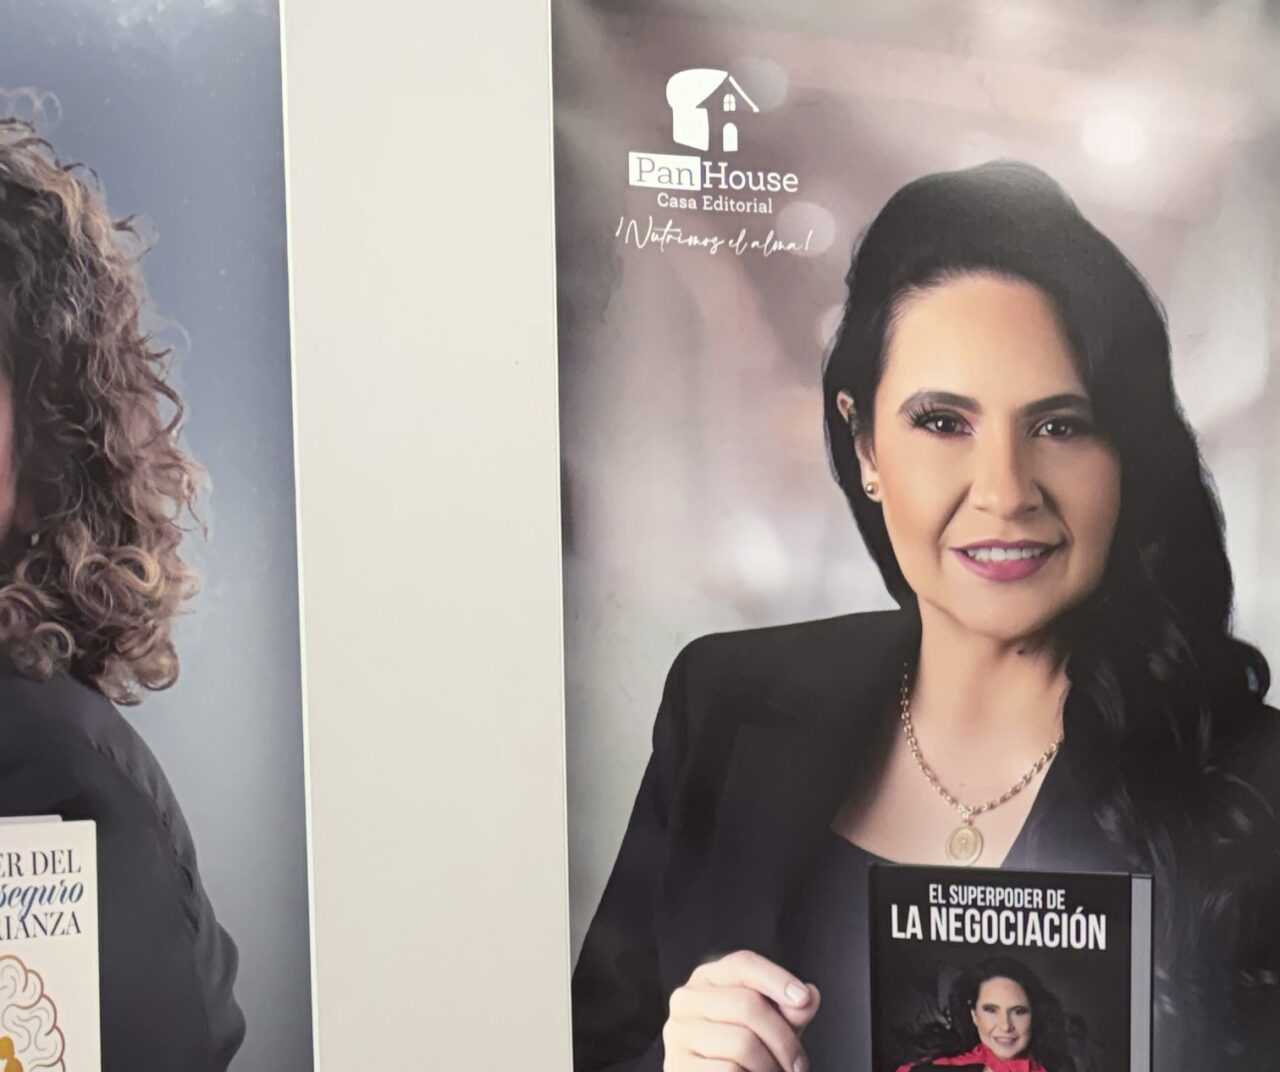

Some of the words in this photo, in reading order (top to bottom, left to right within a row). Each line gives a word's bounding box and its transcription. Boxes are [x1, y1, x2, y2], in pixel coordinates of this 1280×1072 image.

[703, 161, 799, 193] House
[657, 192, 697, 209] Casa
[702, 195, 773, 214] Editorial
[728, 229, 748, 255] el
[751, 230, 814, 257] alma!
[31, 849, 82, 876] DEL
[929, 884, 947, 904] EL
[949, 885, 1043, 909] SUPERPODER
[1047, 888, 1066, 910] DE
[0, 911, 81, 940] IANZA
[891, 904, 923, 940] LA
[931, 907, 1107, 950] NEGOCIACIÓN
